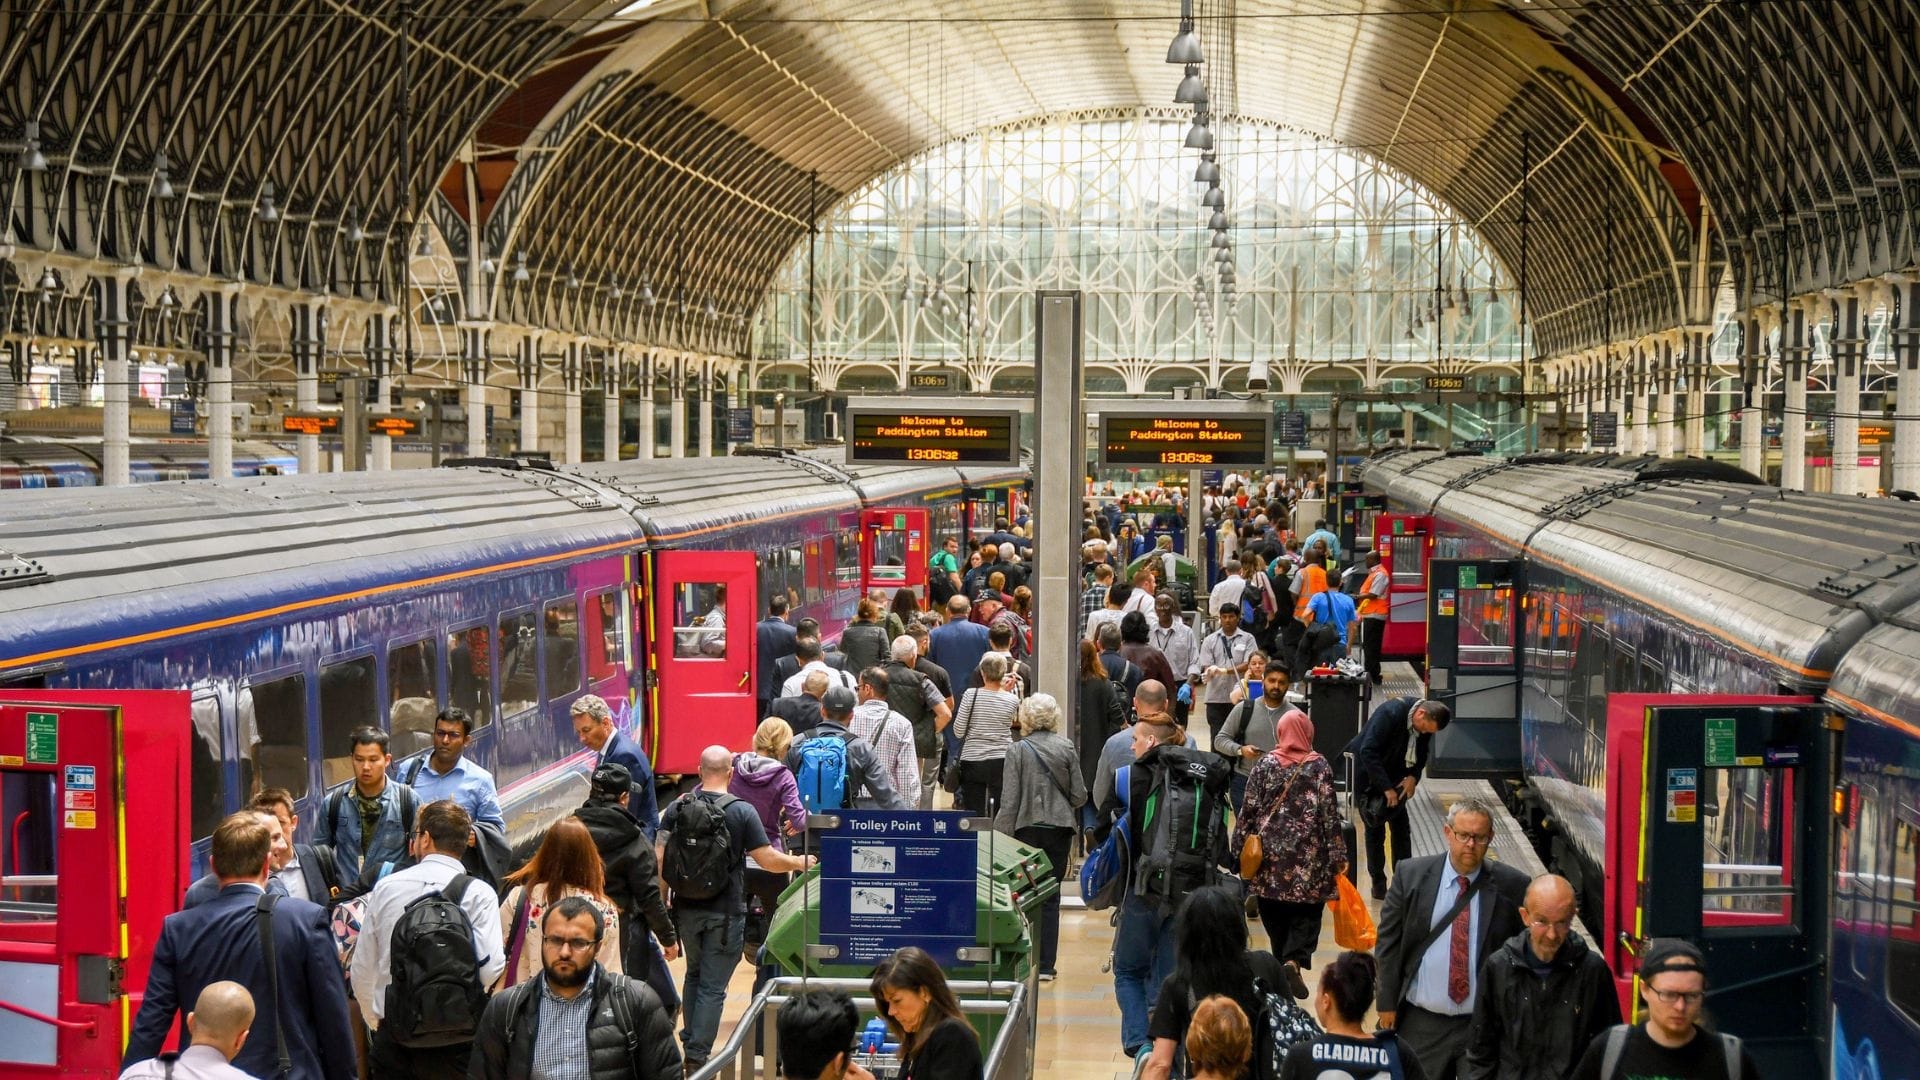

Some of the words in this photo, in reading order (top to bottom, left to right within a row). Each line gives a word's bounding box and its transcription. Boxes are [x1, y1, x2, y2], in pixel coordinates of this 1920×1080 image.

[901, 416, 945, 425] Welcome
[951, 416, 964, 426] to
[1154, 420, 1200, 428] Welcome
[1205, 419, 1218, 428] to
[877, 427, 940, 438] Paddington
[945, 427, 988, 437] Station
[1130, 431, 1194, 441] Paddington
[1199, 431, 1242, 440] Station
[907, 449, 959, 461] 13:06:32
[1161, 452, 1213, 464] 13:06:32
[850, 819, 888, 833] Trolley
[891, 820, 922, 831] Point
